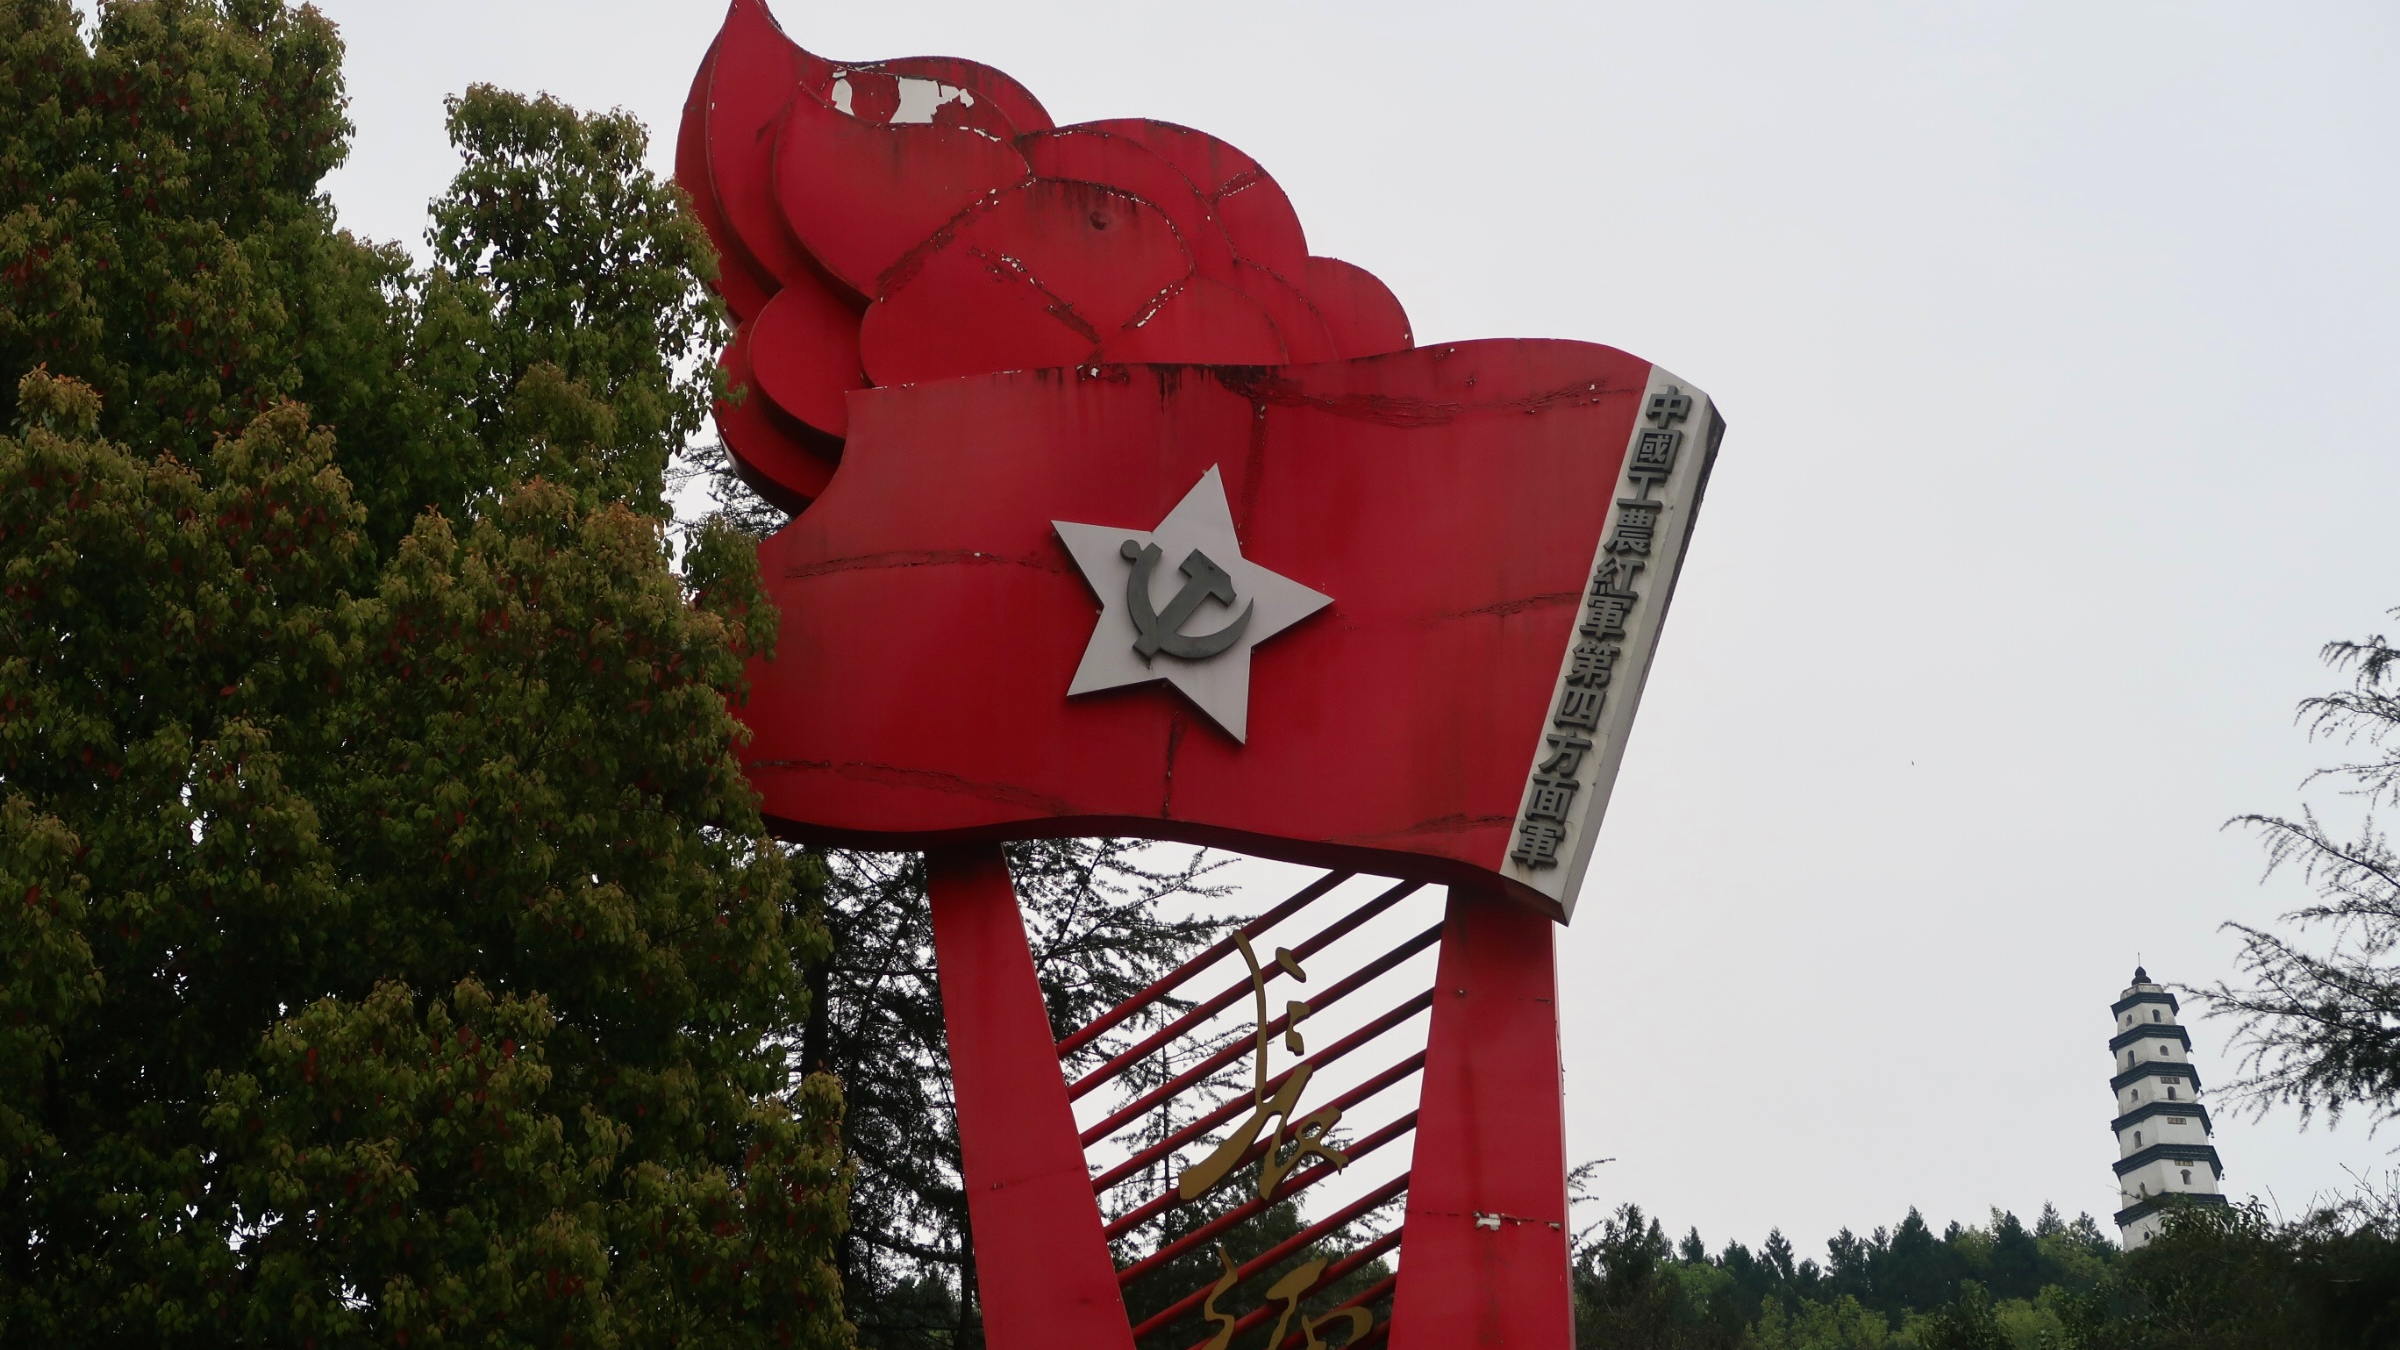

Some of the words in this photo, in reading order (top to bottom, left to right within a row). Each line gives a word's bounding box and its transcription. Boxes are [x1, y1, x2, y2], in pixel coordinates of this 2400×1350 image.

[1510, 385, 1692, 869] 中國工農紅軍第四方面軍
